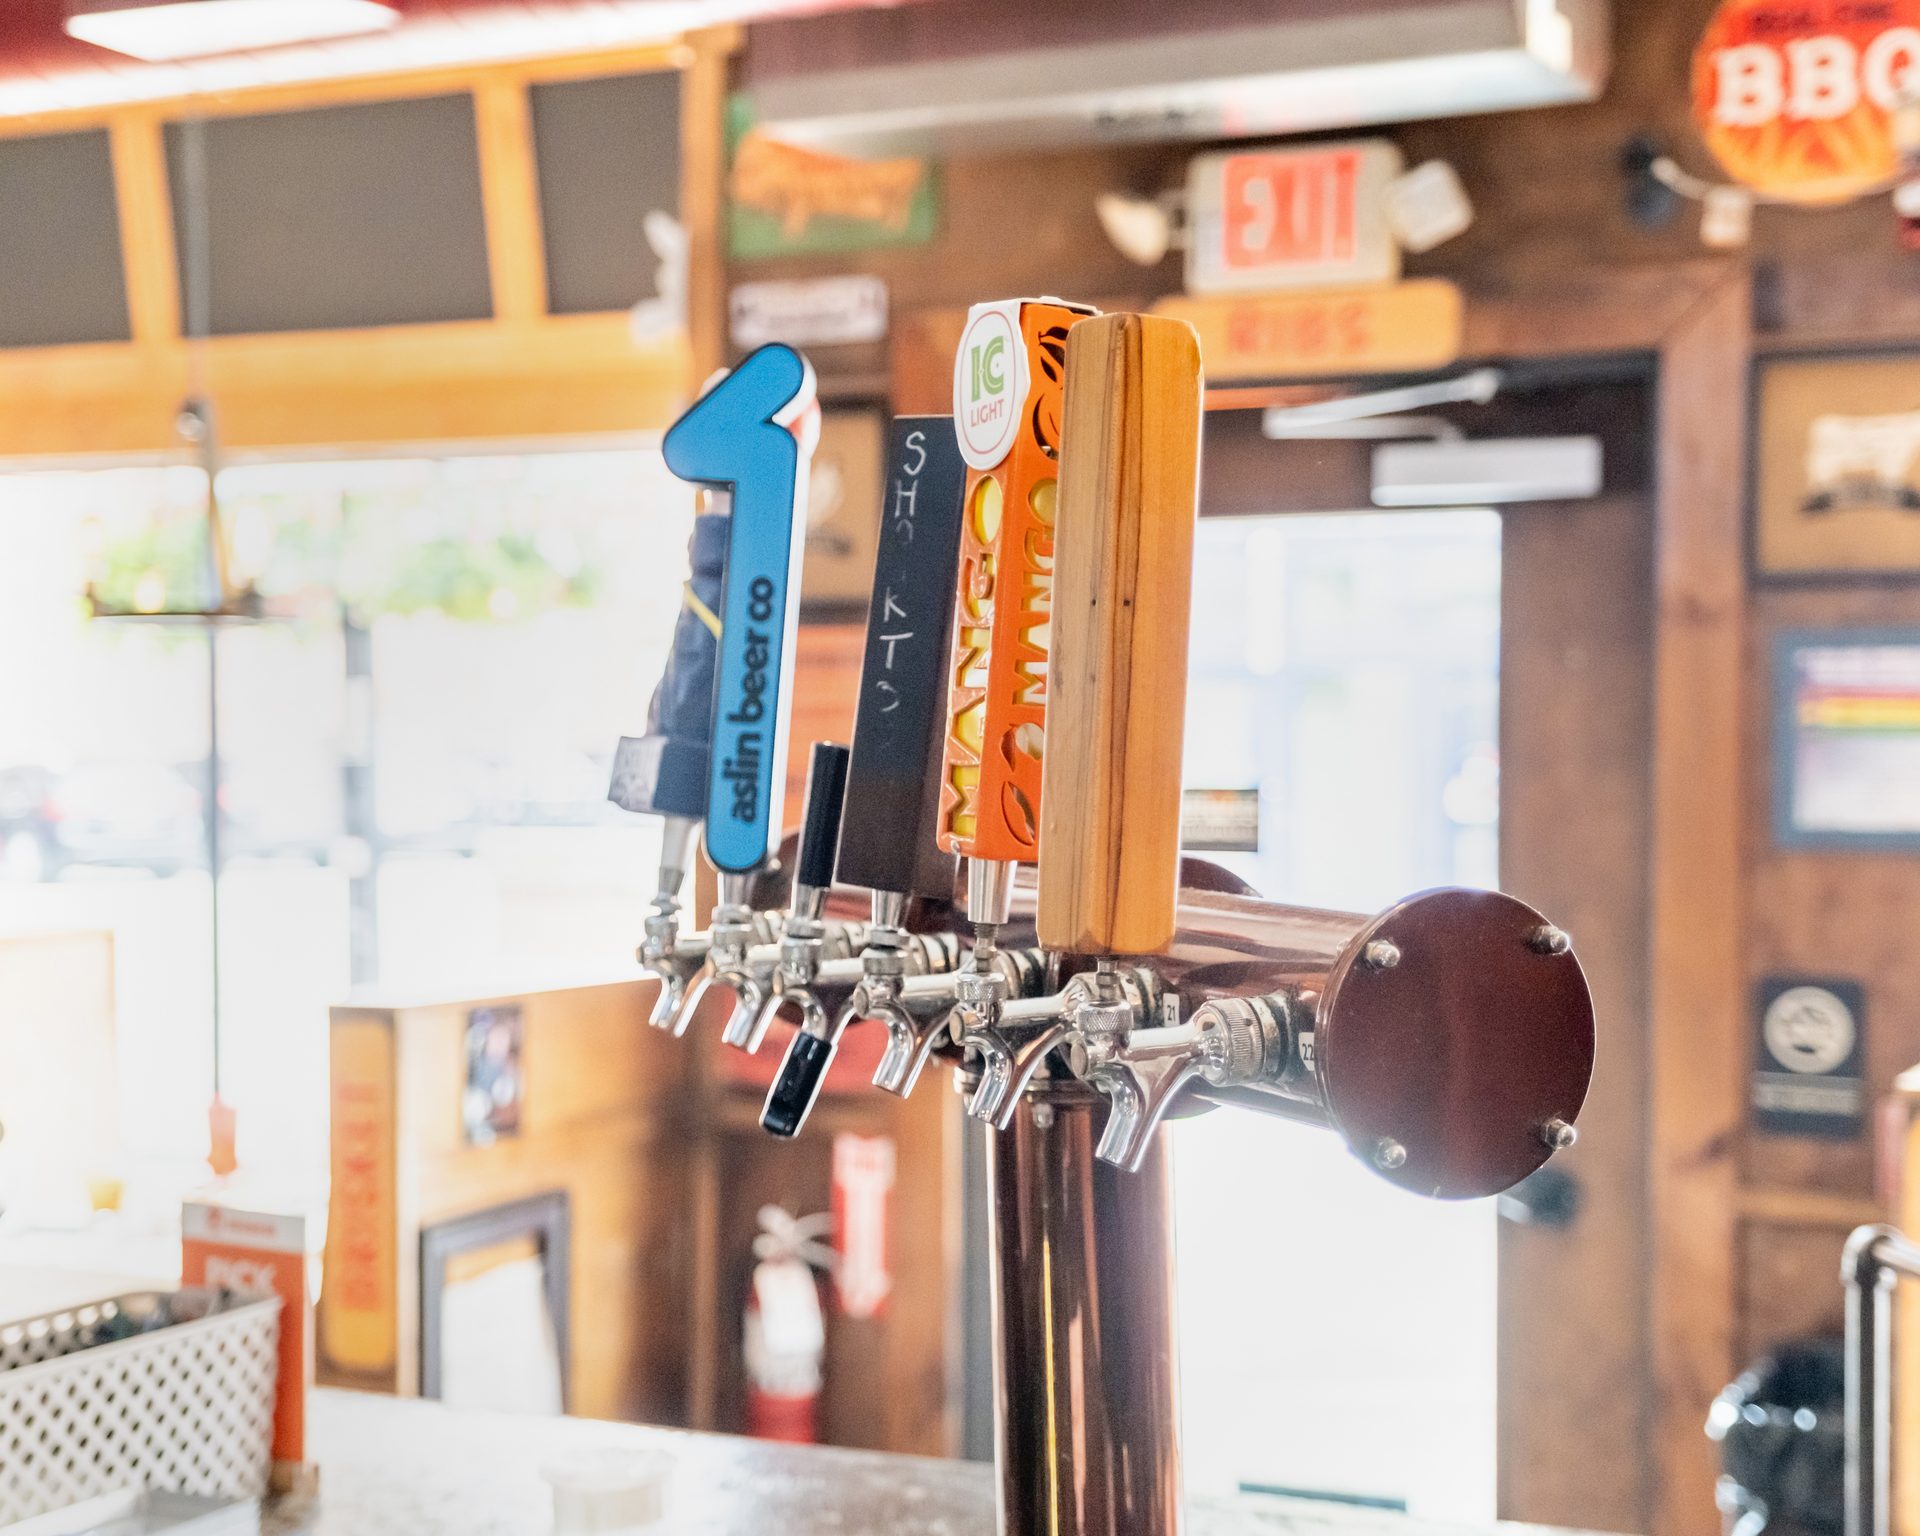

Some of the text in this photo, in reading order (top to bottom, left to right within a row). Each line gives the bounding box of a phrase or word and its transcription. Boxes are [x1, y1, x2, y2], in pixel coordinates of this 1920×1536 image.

[1222, 151, 1363, 270] EXIT
[970, 335, 1005, 403] IC
[970, 398, 1005, 428] LIGHT
[1011, 477, 1058, 706] MANGO
[720, 576, 775, 824] aslin beer co
[945, 474, 1004, 843] MANGO
[1166, 1004, 1176, 1022] 21
[1301, 1042, 1314, 1061] 22
